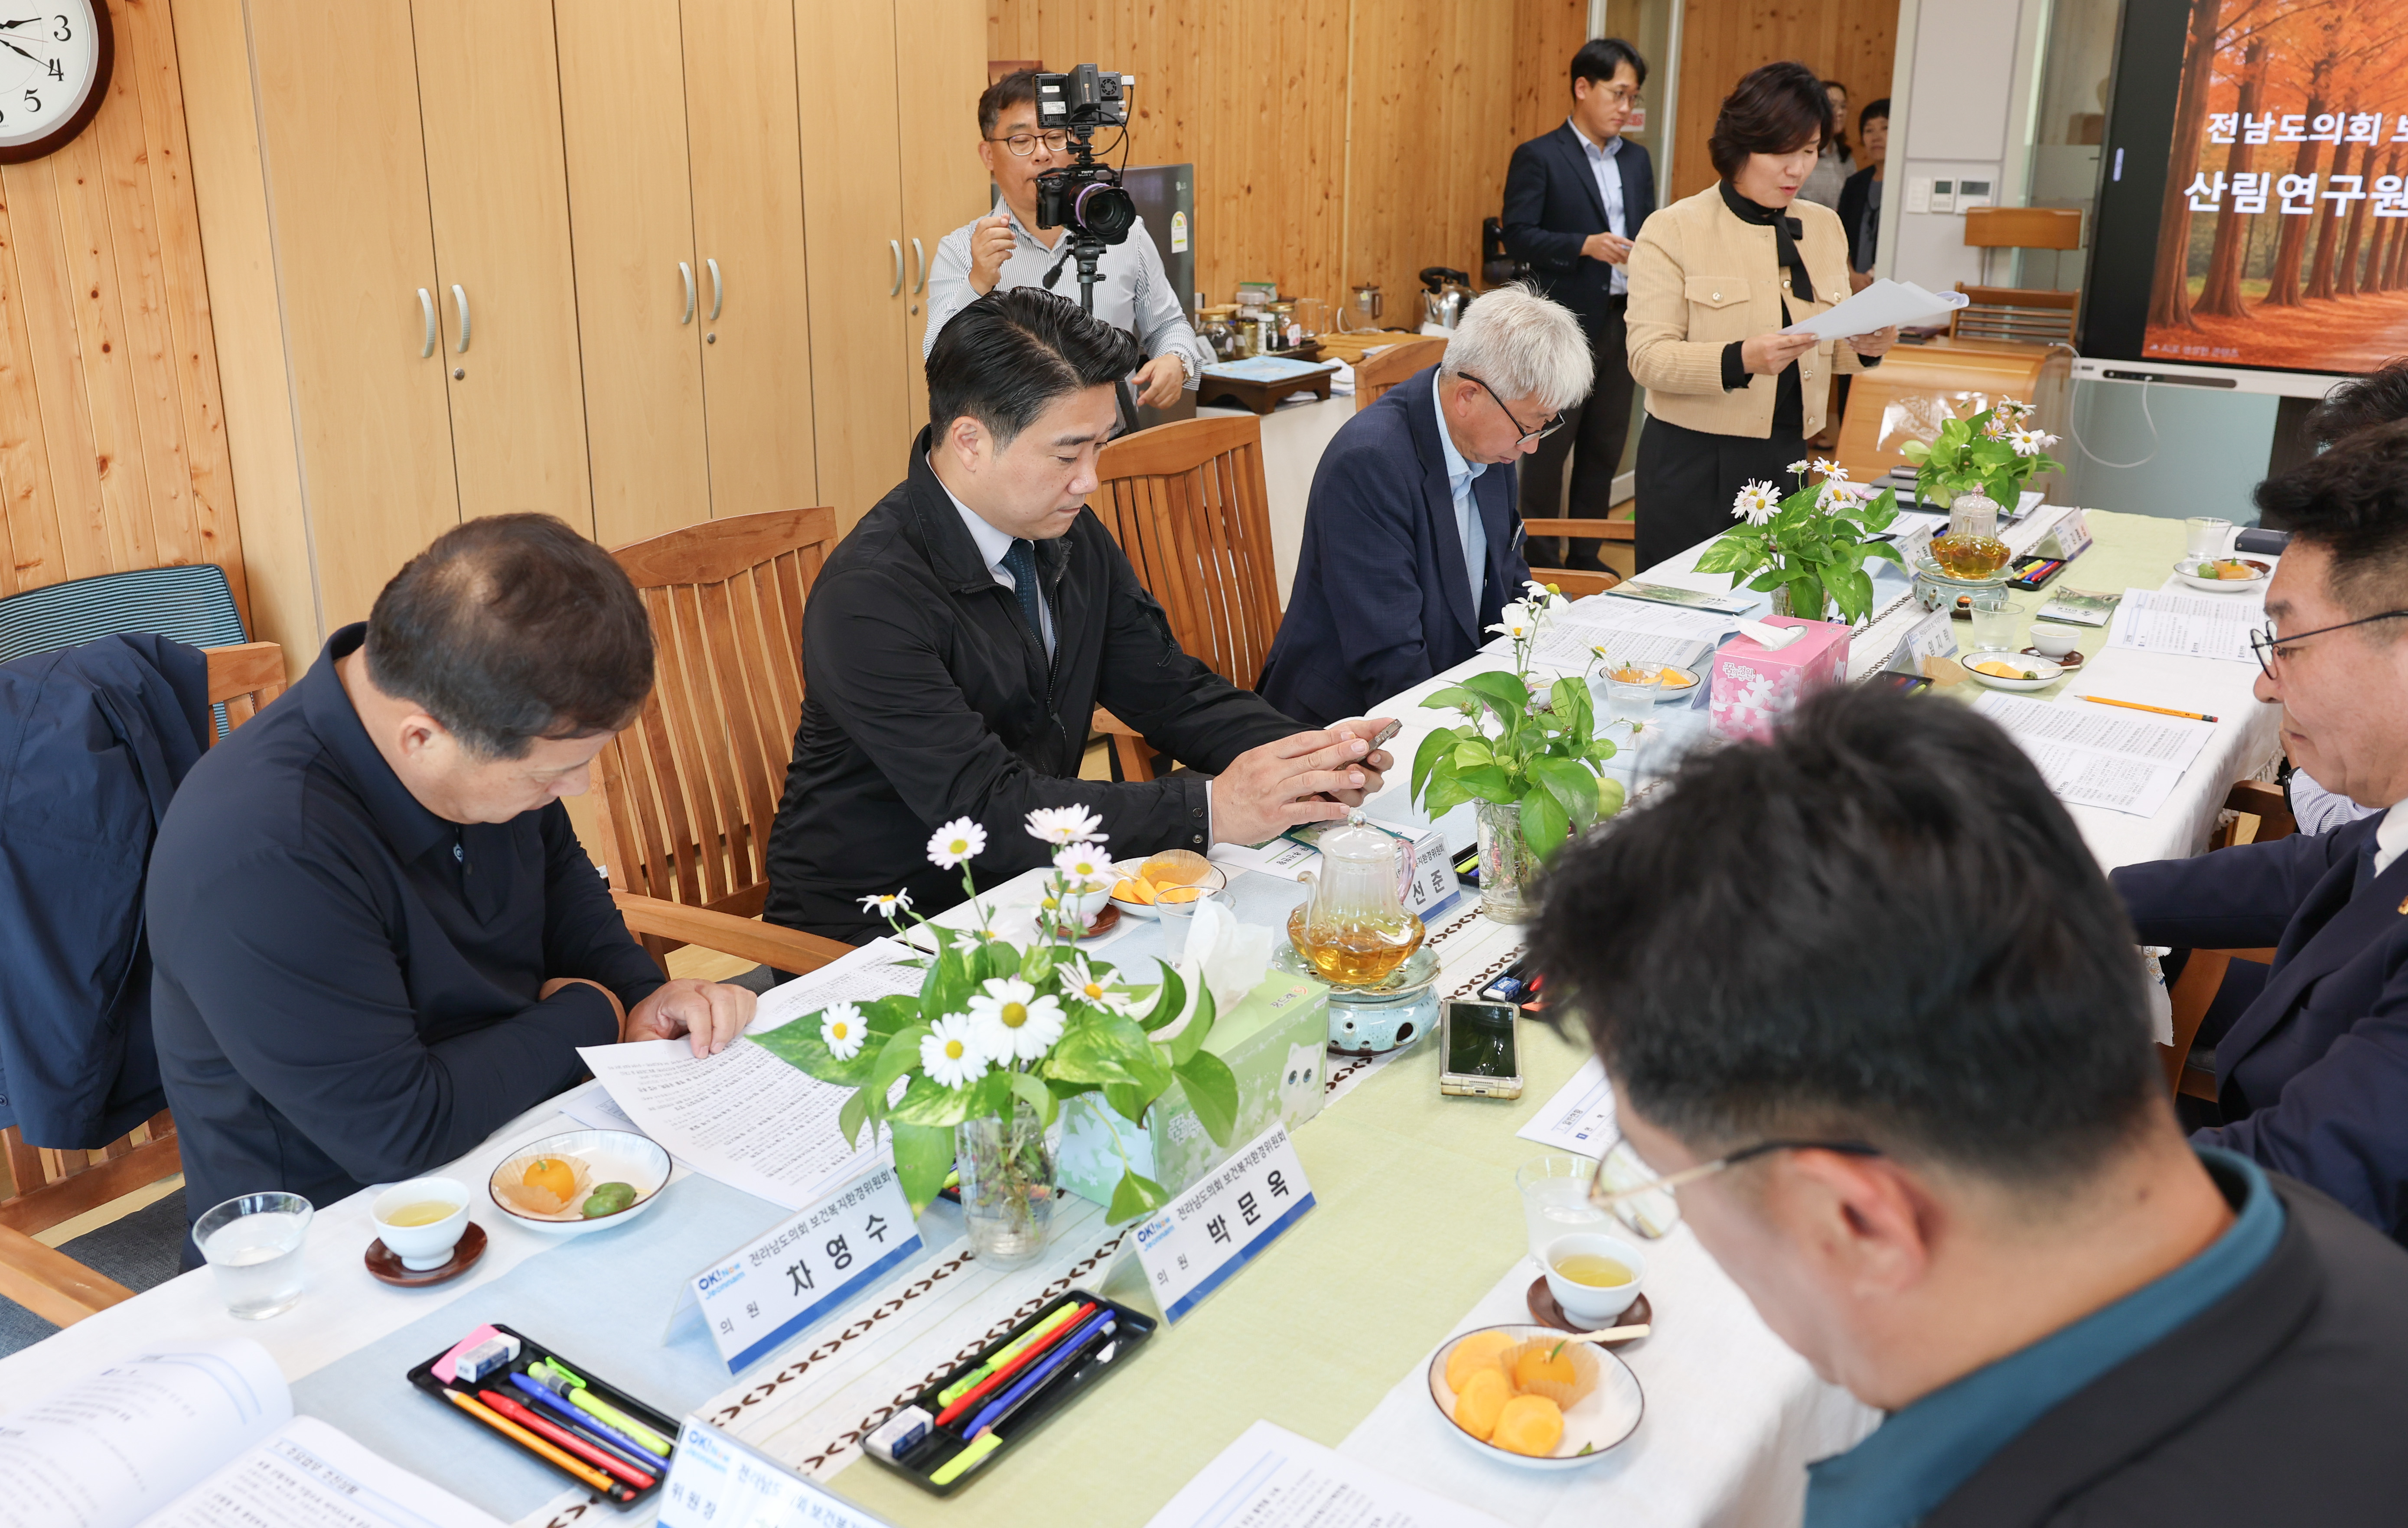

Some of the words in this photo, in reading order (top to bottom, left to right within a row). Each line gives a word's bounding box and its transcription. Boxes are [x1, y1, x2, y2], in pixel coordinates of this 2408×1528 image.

[54, 15, 72, 42] 3
[47, 58, 64, 81] 4
[24, 88, 41, 112] 5
[2207, 111, 2382, 146] 전남도의회
[2184, 171, 2408, 218] 산림연구원
[1416, 843, 1445, 868] 지환경위원회
[1176, 1180, 1224, 1220] 전라남도의회
[1223, 1130, 1287, 1185] 보건복지환경위원회
[749, 1222, 810, 1268] 전라남도의회
[809, 1170, 892, 1229] 보건복지환경위원회
[705, 1271, 746, 1300] Jeonnam
